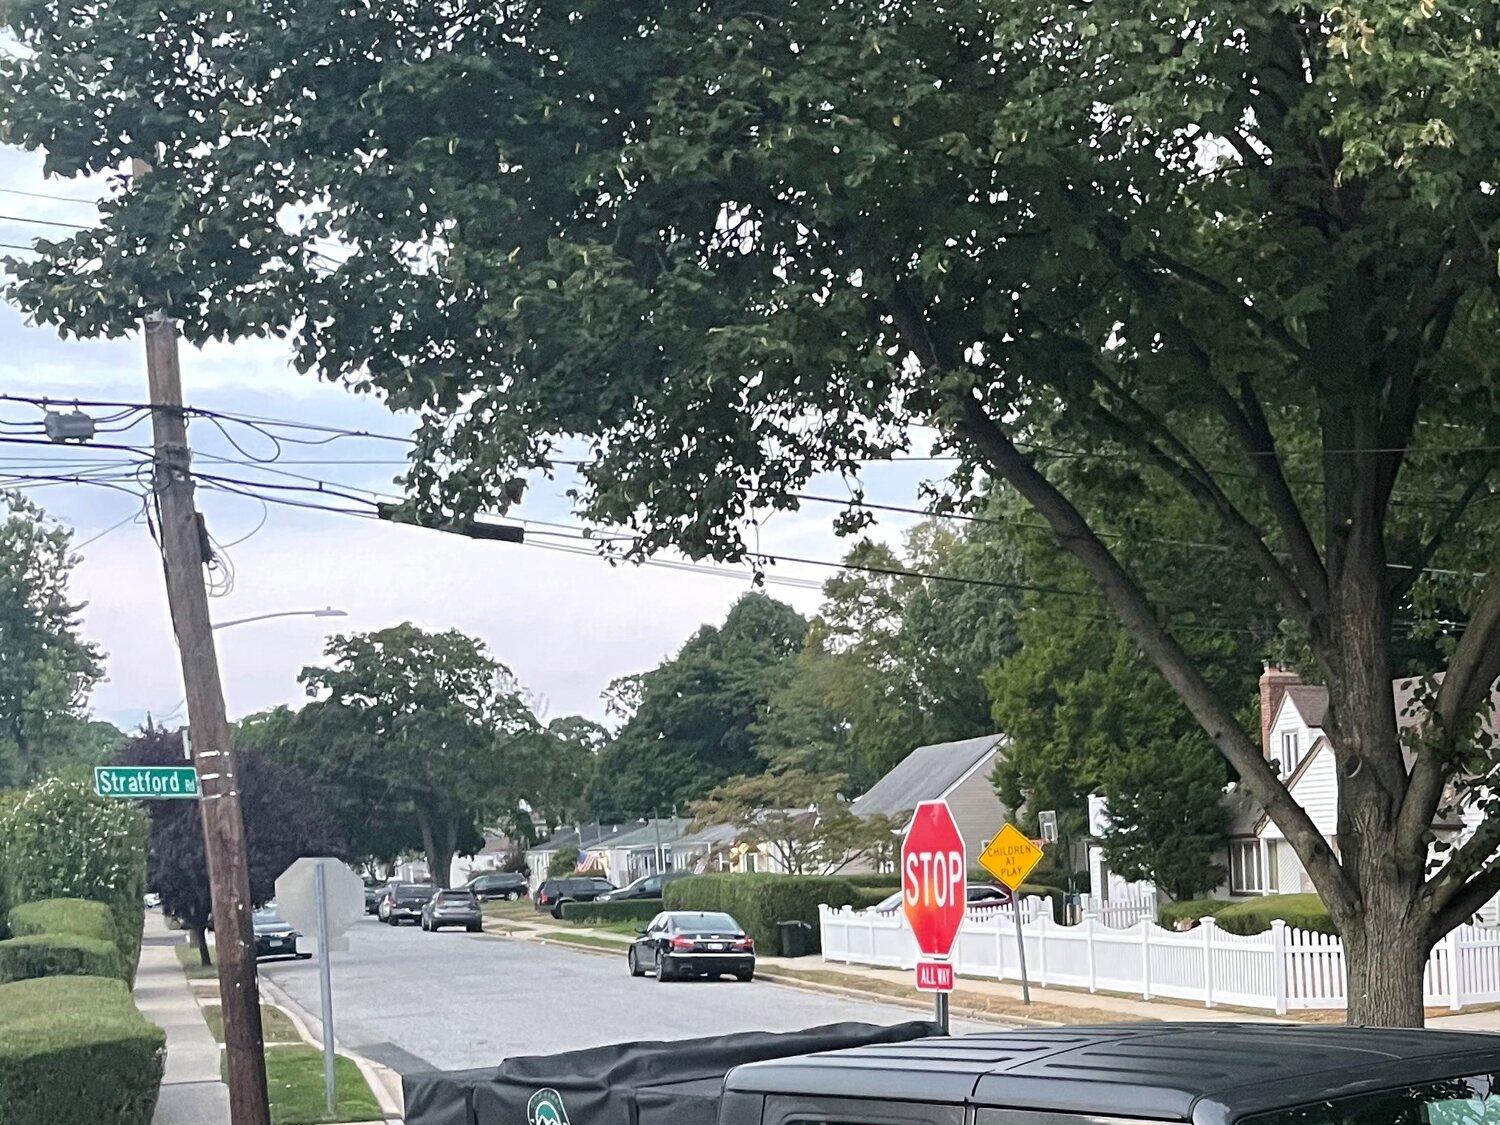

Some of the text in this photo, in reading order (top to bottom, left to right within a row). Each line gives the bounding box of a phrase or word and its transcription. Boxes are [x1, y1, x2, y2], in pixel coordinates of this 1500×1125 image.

[100, 770, 196, 793] Stratford Rd
[987, 844, 1032, 857] CHILDREN
[1006, 857, 1015, 866] AT
[905, 850, 963, 908] STOP
[1000, 866, 1022, 877] PLAY
[920, 966, 951, 986] ALL WAY
